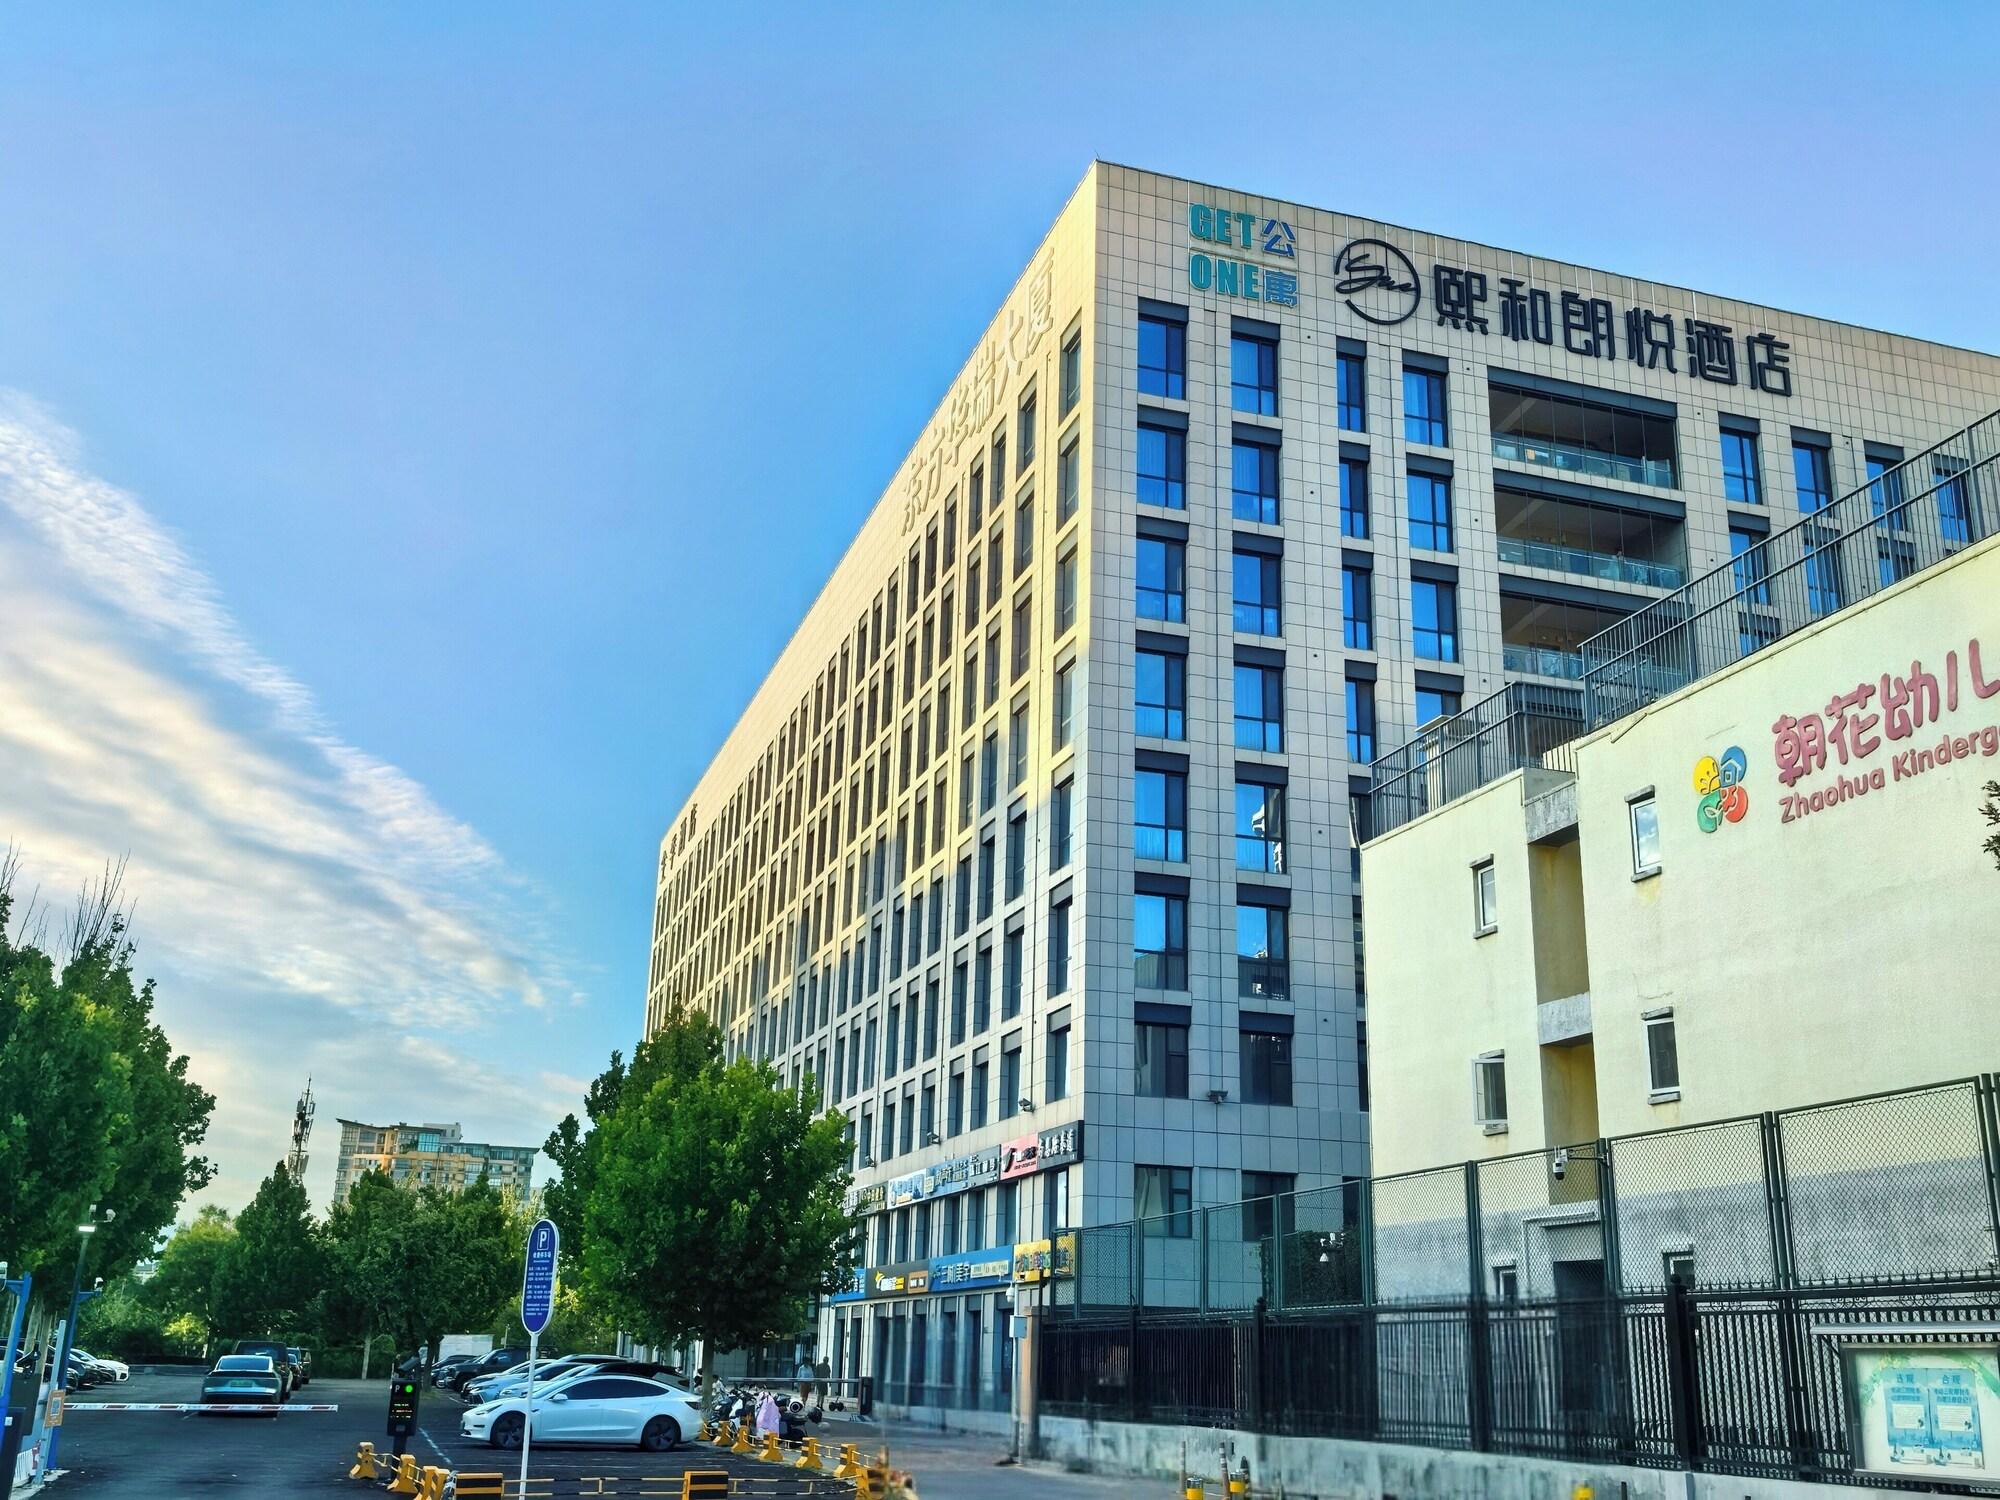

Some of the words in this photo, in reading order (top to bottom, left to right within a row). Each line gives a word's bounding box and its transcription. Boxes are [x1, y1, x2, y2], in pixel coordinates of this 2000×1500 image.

[1189, 203, 1255, 249] GET
[1189, 253, 1260, 300] ONE
[1433, 263, 1792, 398] 熙和朗悦酒店
[1771, 638, 2000, 787] 朝花幼儿
[1778, 767, 1885, 823] Zhaohua
[1892, 724, 2000, 782] Kinderg
[539, 1231, 547, 1248] P
